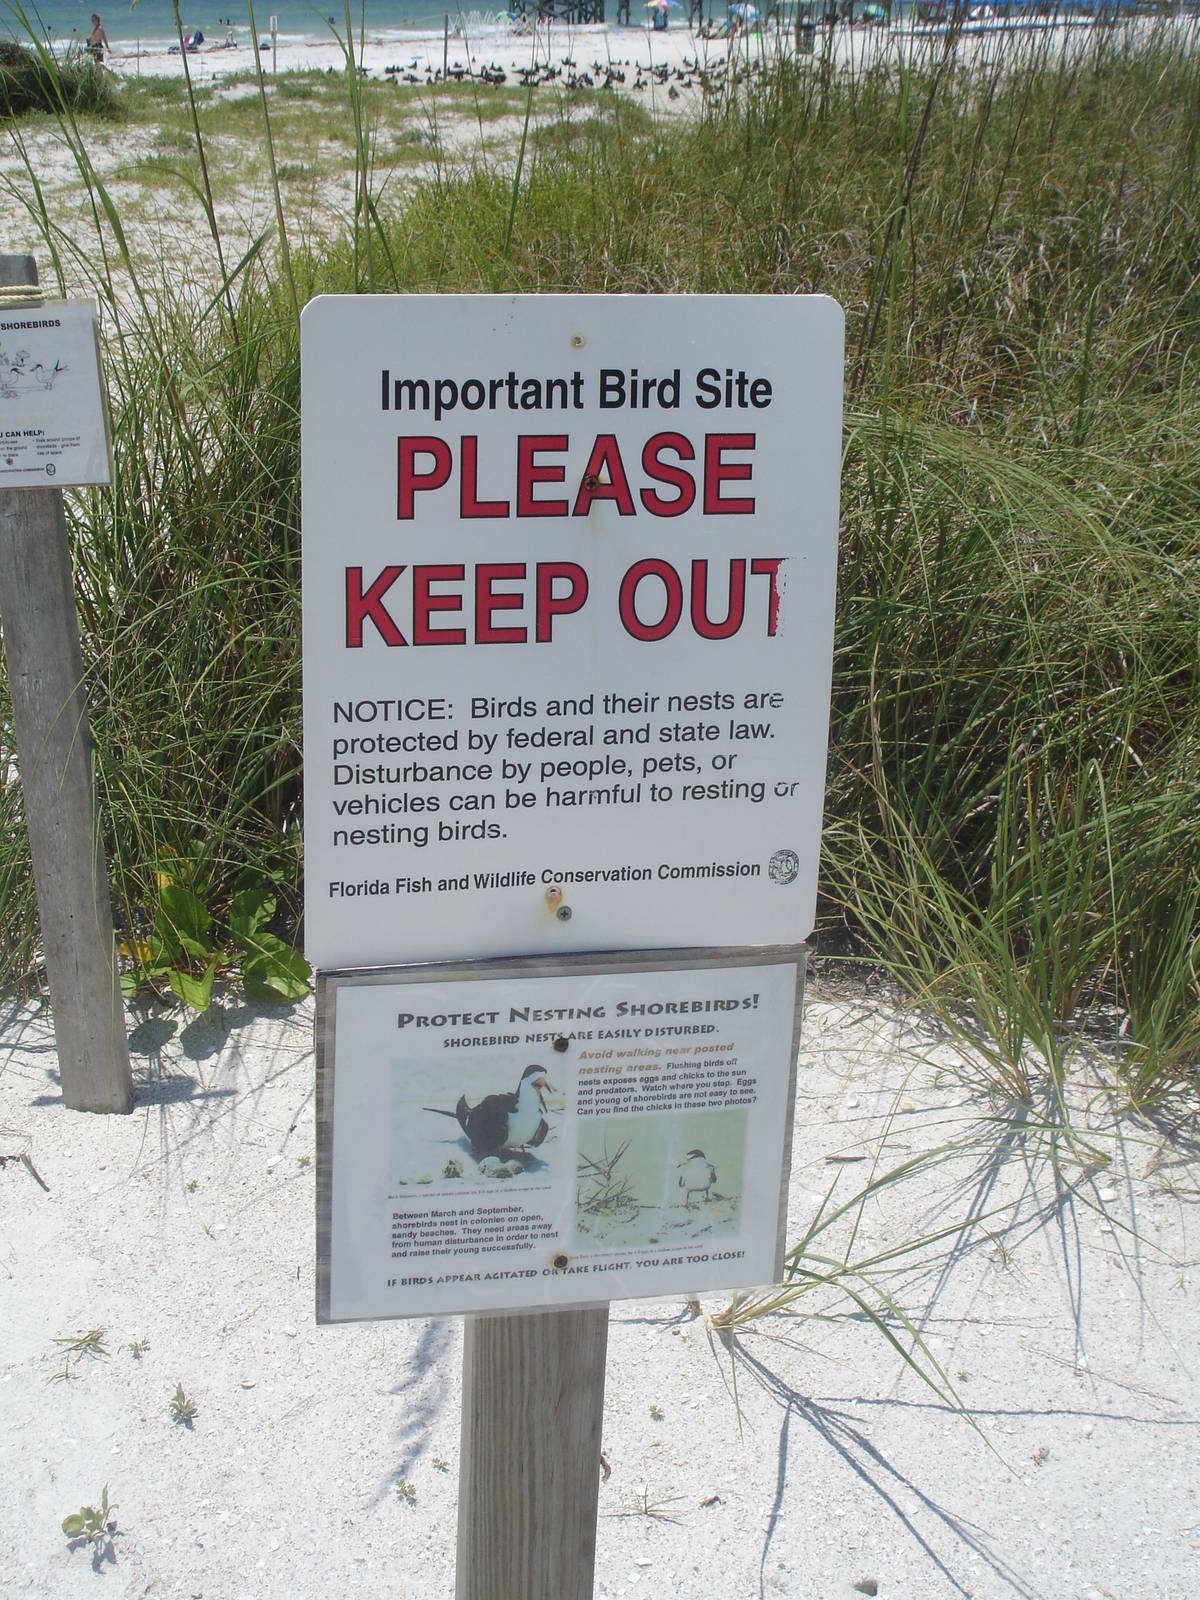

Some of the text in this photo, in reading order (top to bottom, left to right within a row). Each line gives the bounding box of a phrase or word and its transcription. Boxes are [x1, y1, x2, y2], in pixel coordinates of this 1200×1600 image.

[1, 320, 61, 330] SHOREBIRDS
[382, 368, 772, 421] Important Bird Site
[6, 430, 21, 438] CAN
[397, 431, 756, 520] PLEASE
[346, 562, 589, 648] KEEP
[334, 691, 783, 723] NOTICE: Birds and their nests are
[334, 720, 774, 760] protected by federal and state law.
[334, 753, 737, 785] Disturbance by people, pets, or
[333, 779, 799, 815] vehicles can be harmful to resting or
[334, 820, 506, 847] nesting birds.
[330, 880, 389, 897] Florida
[396, 877, 431, 893] Fish
[438, 875, 469, 891] and
[474, 871, 535, 888] Wildlife
[542, 866, 651, 883] Conservation
[658, 862, 760, 879] Commission
[398, 1012, 499, 1028] PROTECT
[510, 1007, 606, 1022] NESTING
[444, 1024, 719, 1048] SHOREBIRD NESTS ARE EASILY DISTURBED.
[579, 1043, 734, 1059] Avoid walking near posted
[579, 1065, 622, 1075] nesting
[626, 1063, 662, 1072] areas.
[603, 1077, 636, 1085] exposes
[640, 1075, 659, 1083] eggs
[679, 1072, 704, 1080] chicks
[595, 1087, 637, 1096] predators.
[737, 1079, 757, 1087] Eggs
[595, 1096, 621, 1105] young
[633, 1093, 676, 1102] shorebirds
[709, 1090, 727, 1098] easy
[595, 1108, 610, 1116] you
[646, 1103, 672, 1111] chicks
[725, 1096, 757, 1106] photos?
[470, 1216, 505, 1224] colonies
[521, 1215, 543, 1223] open,
[477, 1206, 524, 1215] September,
[392, 1231, 417, 1240] sandy
[420, 1229, 456, 1237] beaches.
[462, 1228, 482, 1236] They
[532, 1223, 552, 1231] away
[445, 1237, 494, 1245] disturbance
[453, 1247, 479, 1255] young
[482, 1243, 536, 1252] successfully.
[401, 1277, 433, 1286] BIRDS
[436, 1273, 480, 1284] APPEAR
[484, 1270, 537, 1280] AGITATED
[562, 1266, 588, 1276] TAKE
[637, 1259, 659, 1268] YOU
[663, 1256, 683, 1266] ARE
[687, 1254, 709, 1264] TOO
[712, 1250, 746, 1261] CLOSE!
